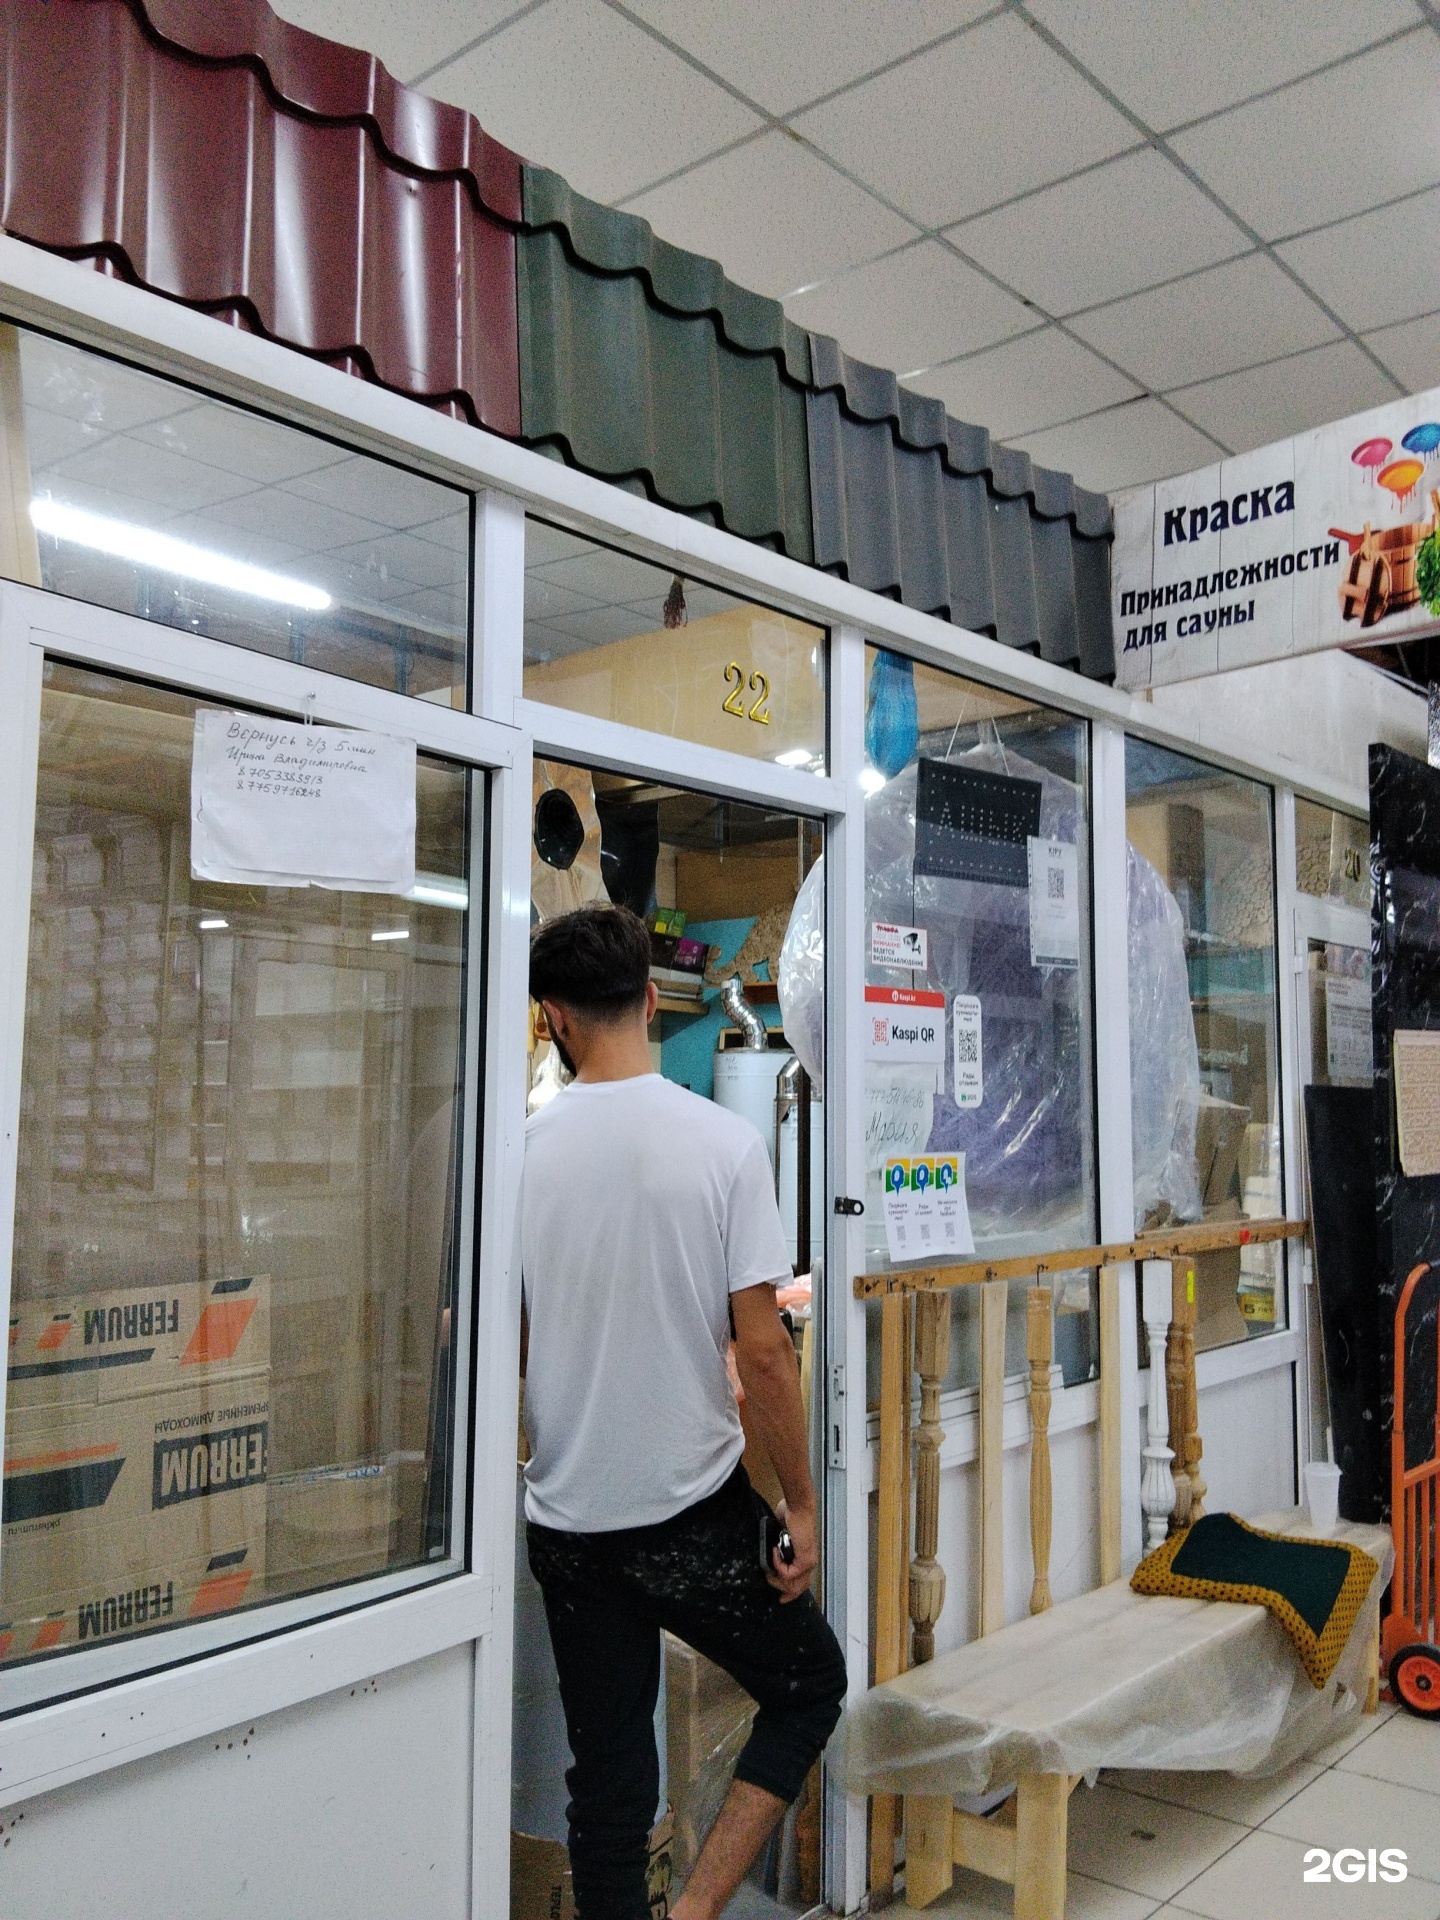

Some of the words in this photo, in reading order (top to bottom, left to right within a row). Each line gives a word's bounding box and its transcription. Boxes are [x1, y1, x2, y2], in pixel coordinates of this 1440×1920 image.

[1163, 480, 1295, 546] Краска
[1119, 541, 1339, 617] Принадлежности
[1123, 620, 1167, 653] для
[1176, 600, 1255, 638] сауны
[722, 661, 771, 725] 22
[225, 746, 265, 766] Ирина
[227, 722, 296, 750] Вернусь
[891, 1025, 919, 1044] Kaspi
[920, 1027, 935, 1043] QR
[84, 1299, 179, 1345] FERRUM
[154, 1410, 214, 1434] ДЫМОХОДЫ
[78, 1580, 174, 1640] FERRUM
